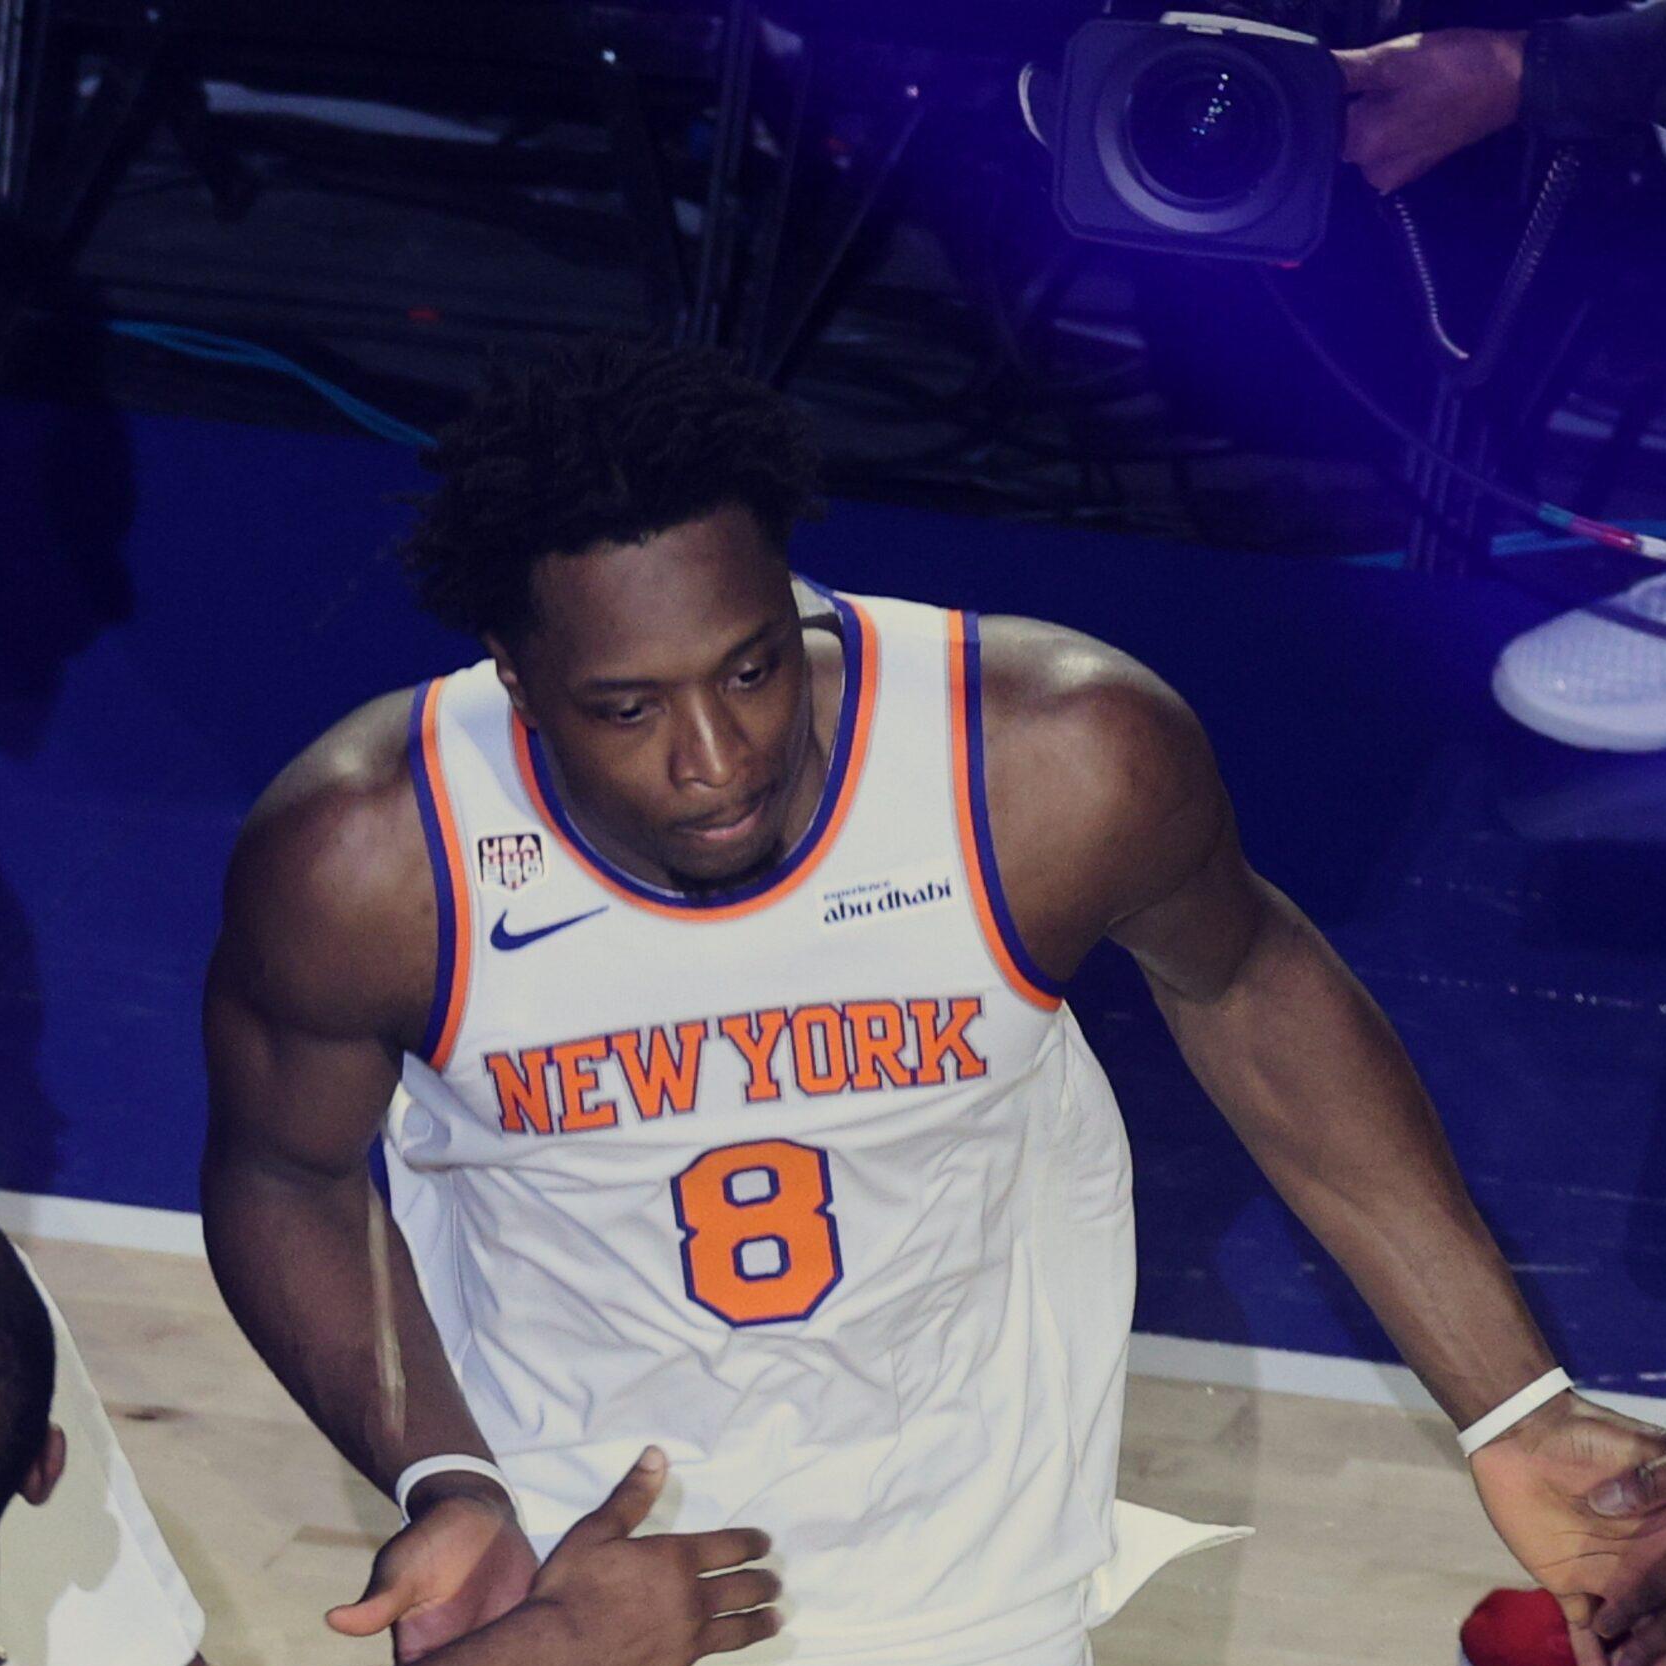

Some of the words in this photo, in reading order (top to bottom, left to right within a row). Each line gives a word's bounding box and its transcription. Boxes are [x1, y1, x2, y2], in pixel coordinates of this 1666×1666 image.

[824, 901, 872, 923] abu
[877, 876, 952, 912] dhabi
[485, 1019, 708, 1135] NEW
[719, 997, 988, 1103] YORK
[671, 1137, 844, 1328] 8
